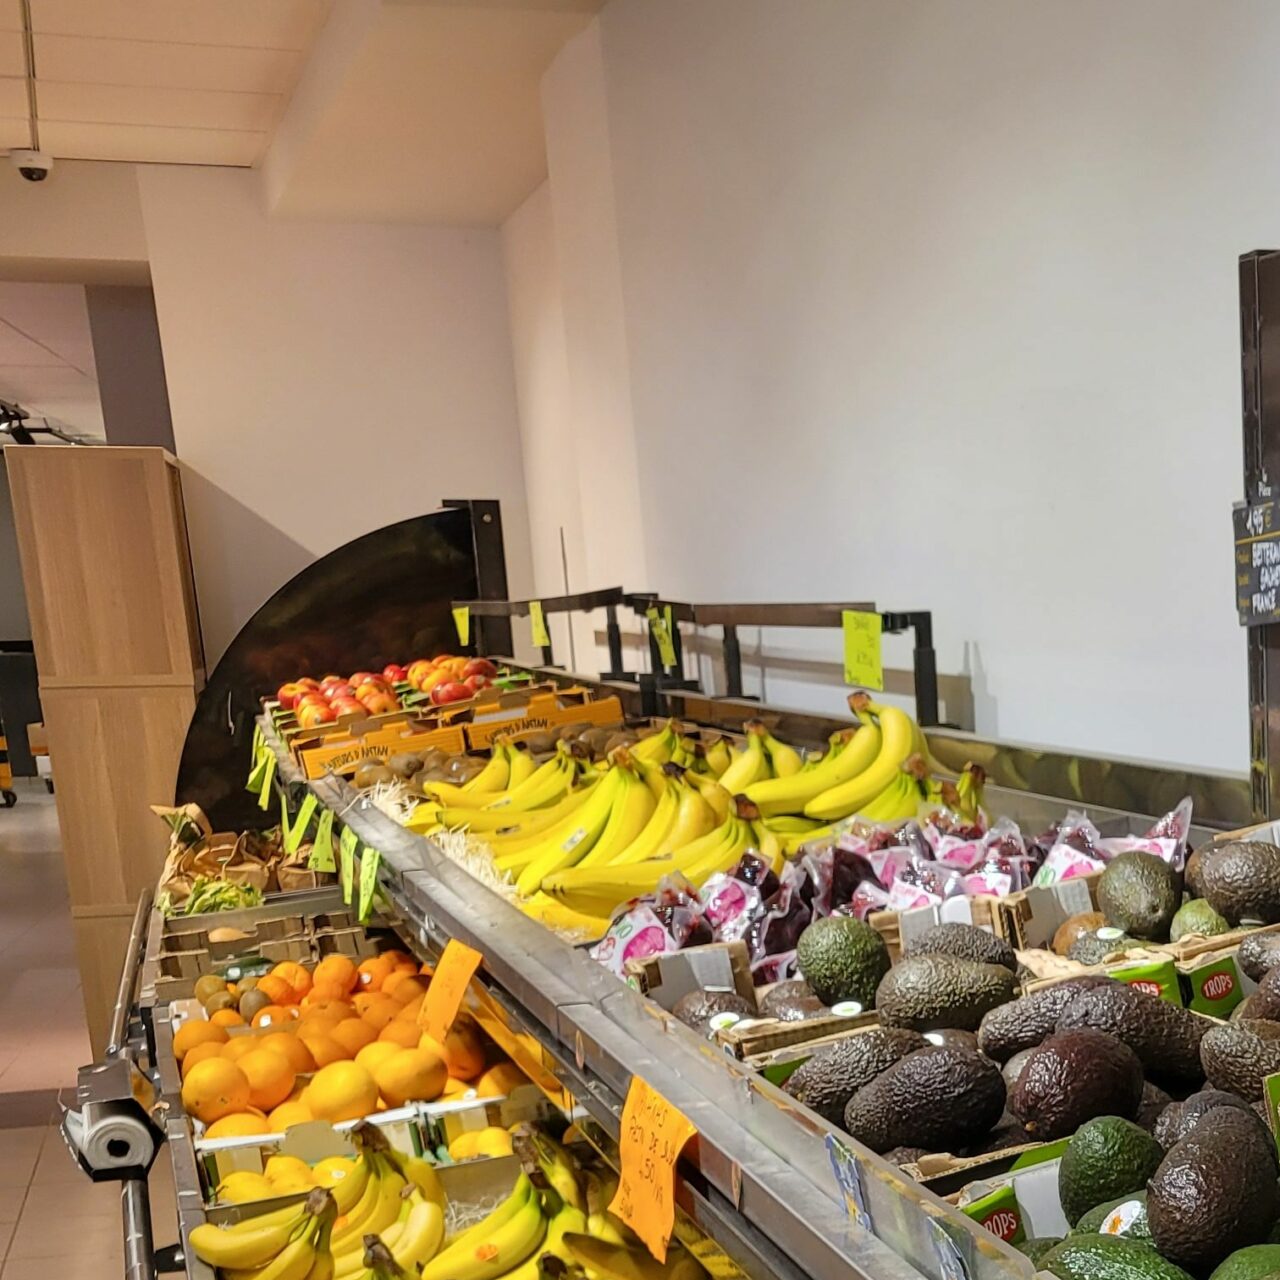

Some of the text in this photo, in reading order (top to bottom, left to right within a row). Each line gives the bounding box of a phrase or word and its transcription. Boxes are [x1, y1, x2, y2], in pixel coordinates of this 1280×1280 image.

[1252, 588, 1277, 615] FRANCE
[1203, 974, 1233, 998] TROPS
[984, 1212, 1017, 1238] ROPS
